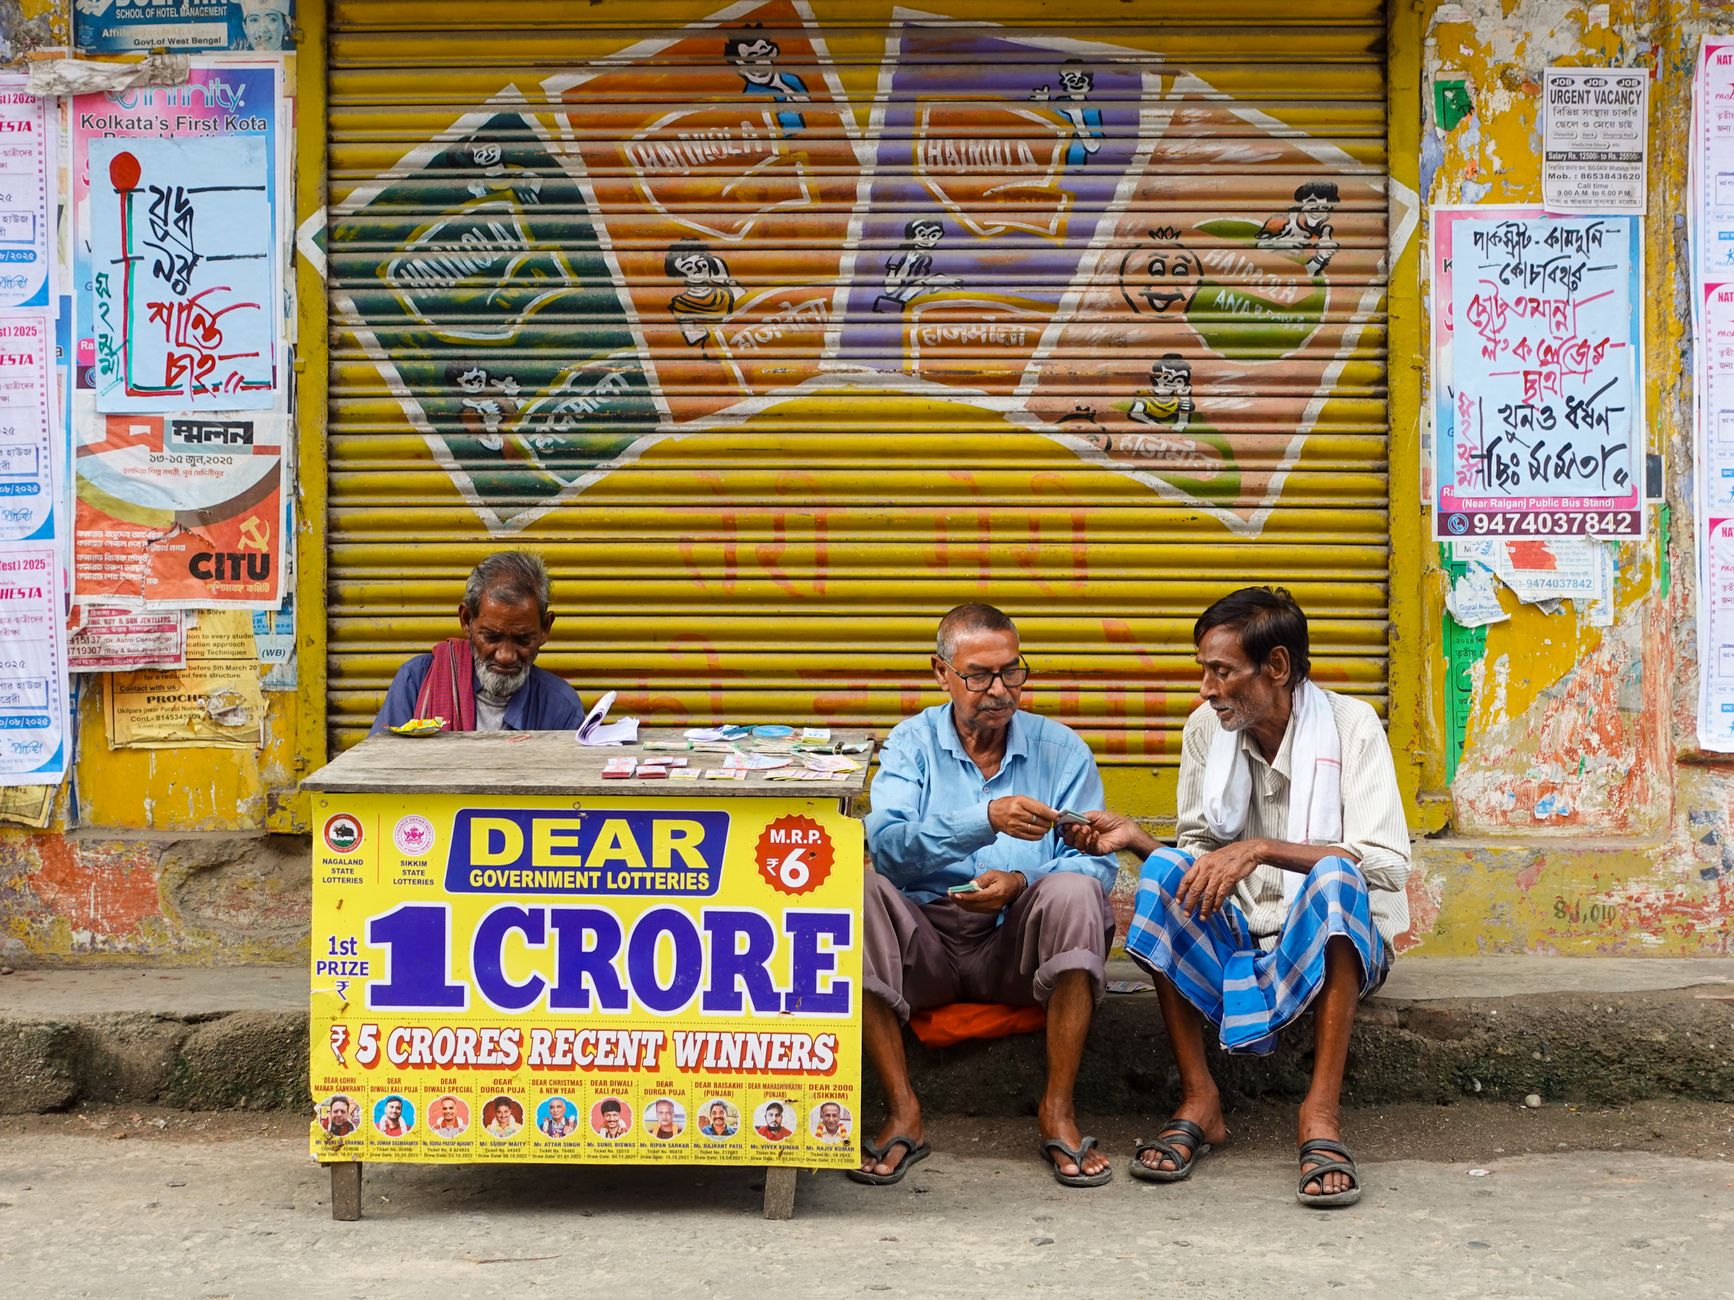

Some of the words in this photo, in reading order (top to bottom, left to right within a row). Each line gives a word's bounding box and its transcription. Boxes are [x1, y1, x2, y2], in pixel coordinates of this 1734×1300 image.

[116, 9, 142, 19] SCHOOL
[145, 8, 155, 18] OF
[156, 8, 179, 18] HOTEL
[180, 6, 227, 17] MANAGEMENT
[167, 37, 190, 46] West
[192, 36, 222, 47] Bengal
[1550, 89, 1591, 104] URGENT
[1594, 90, 1642, 105] VACANCY
[1553, 106, 1578, 117] বিভিন্ন
[1582, 109, 1608, 117] সংস্থায়
[1612, 107, 1637, 117] চাকরি
[81, 114, 169, 130] Kolkata's
[176, 115, 218, 131] First
[225, 115, 267, 131] Kota
[1548, 152, 1568, 161] Salary
[13, 326, 37, 337] 2025
[150, 454, 183, 464] ১৩-১৫
[1462, 499, 1489, 509] (Near
[1490, 499, 1526, 510] Raiganj
[1529, 499, 1560, 509] Public
[1562, 499, 1581, 509] Bus
[1583, 499, 1615, 510] Stand)
[1473, 512, 1632, 534] 9474037842
[23, 558, 46, 571] 2025
[189, 552, 271, 581] CITU
[1526, 579, 1592, 589] 9474037842
[212, 641, 246, 649] approach
[261, 648, 286, 659] (WB)
[161, 672, 191, 680] reduced
[119, 684, 147, 692] Contact
[770, 828, 823, 845] M.R.P.
[470, 817, 709, 869] DEAR
[322, 858, 364, 866] NAGALAND
[331, 867, 355, 875] STATE
[322, 876, 364, 884] LOTTERIES
[393, 878, 435, 886] LOTTERIES
[470, 869, 602, 889] GOVERNMENT
[606, 871, 710, 891] LOTTERIES
[328, 935, 358, 956] 1st
[369, 905, 466, 1009] 1
[473, 906, 852, 1013] CRORE
[316, 960, 369, 977] PRIZE
[355, 1024, 380, 1066] 5
[386, 1025, 522, 1068] CRORES
[527, 1029, 666, 1068] RECENT
[672, 1031, 838, 1073] WINNERS
[704, 1090, 734, 1098] (PUNJAB)
[764, 1091, 787, 1099] (PUNJAB)
[813, 1092, 848, 1100] (SIKKIM)
